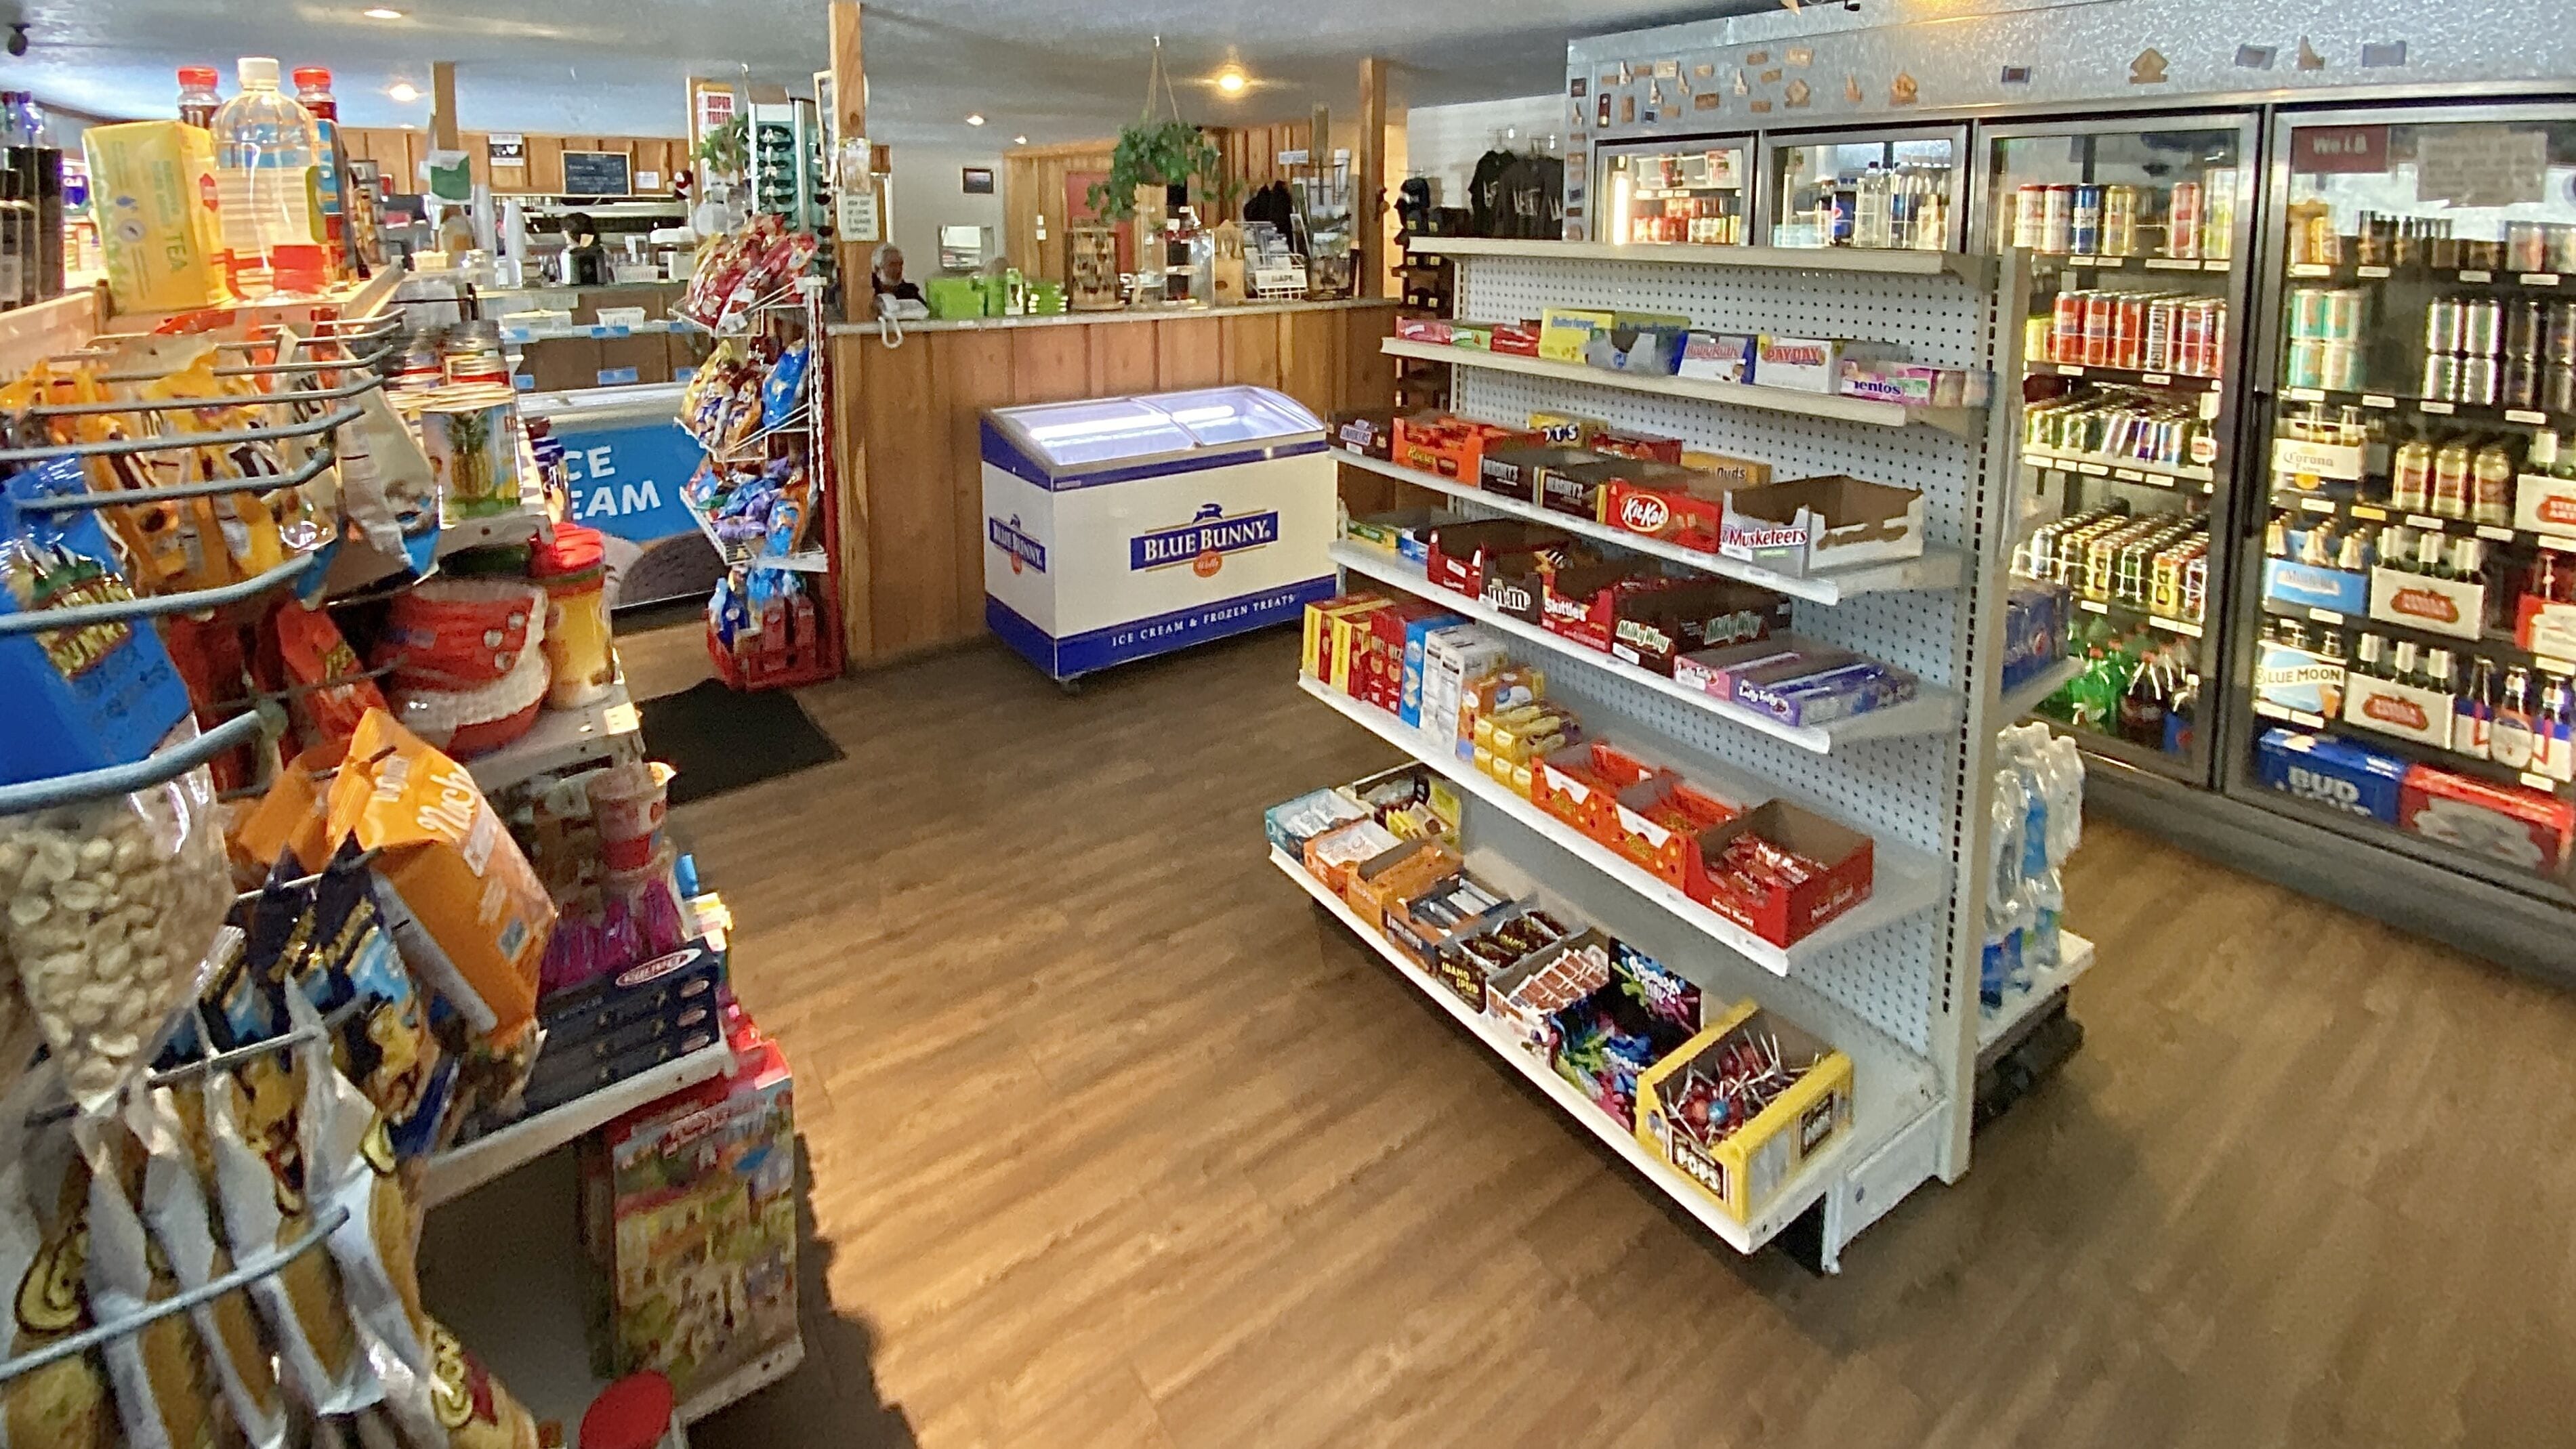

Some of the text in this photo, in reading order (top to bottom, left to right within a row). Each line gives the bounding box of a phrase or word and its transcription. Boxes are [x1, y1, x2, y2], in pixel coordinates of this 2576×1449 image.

[163, 232, 187, 273] TEA
[1854, 381, 1901, 394] entos
[2283, 452, 2334, 467] Corona
[1144, 533, 1197, 562] BLUE
[1728, 528, 1808, 547] Musketeers
[1113, 593, 1295, 647] ICE CREAM & FROZEN TREATS
[1544, 597, 1588, 623] Skittles
[2256, 666, 2340, 685] BLUE MOON
[2288, 765, 2359, 803] BUD
[1441, 961, 1470, 982] IDAHO
[1456, 978, 1480, 994] SPUD
[1675, 1143, 1721, 1192] POPS
